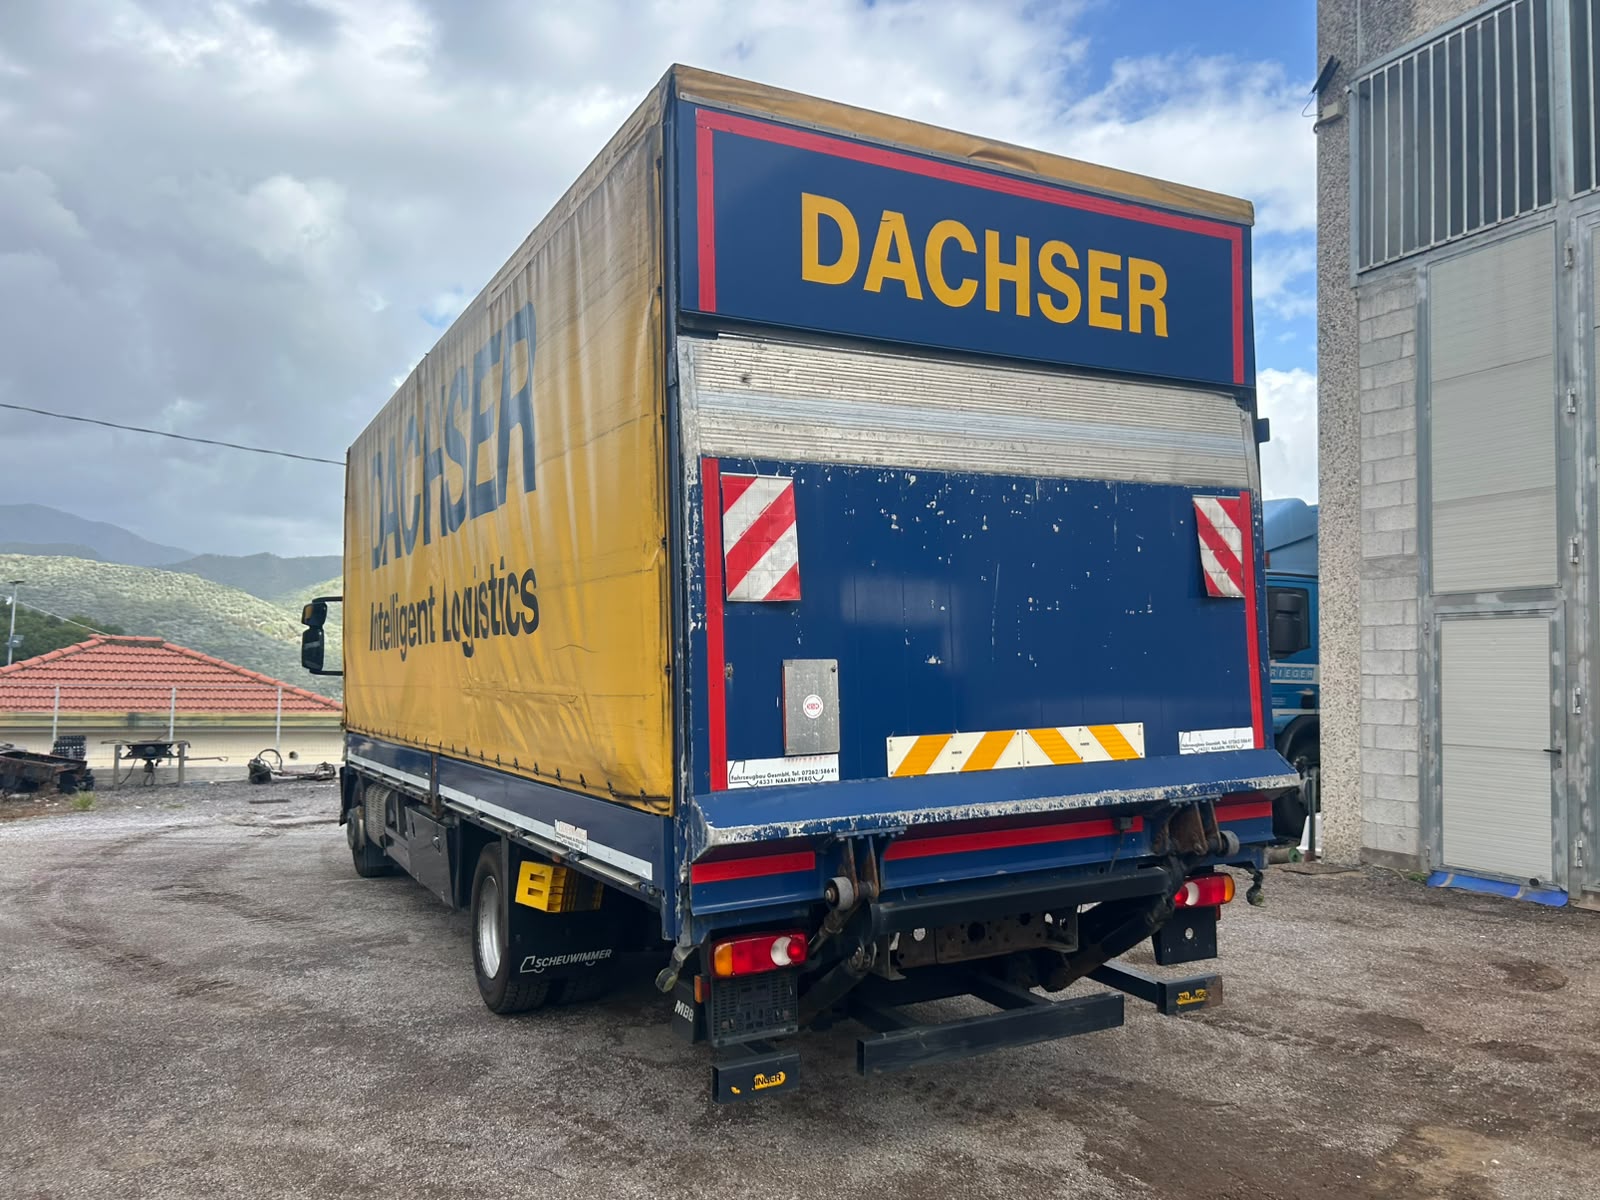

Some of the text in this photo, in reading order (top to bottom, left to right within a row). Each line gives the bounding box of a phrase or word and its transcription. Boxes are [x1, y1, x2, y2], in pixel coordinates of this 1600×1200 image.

[802, 192, 1168, 338] DACHSER
[370, 301, 537, 571] DACHSER
[370, 556, 540, 662] Intelligent Logistics
[535, 949, 612, 968] SCHEUWIMMER
[674, 1000, 695, 1023] MBB
